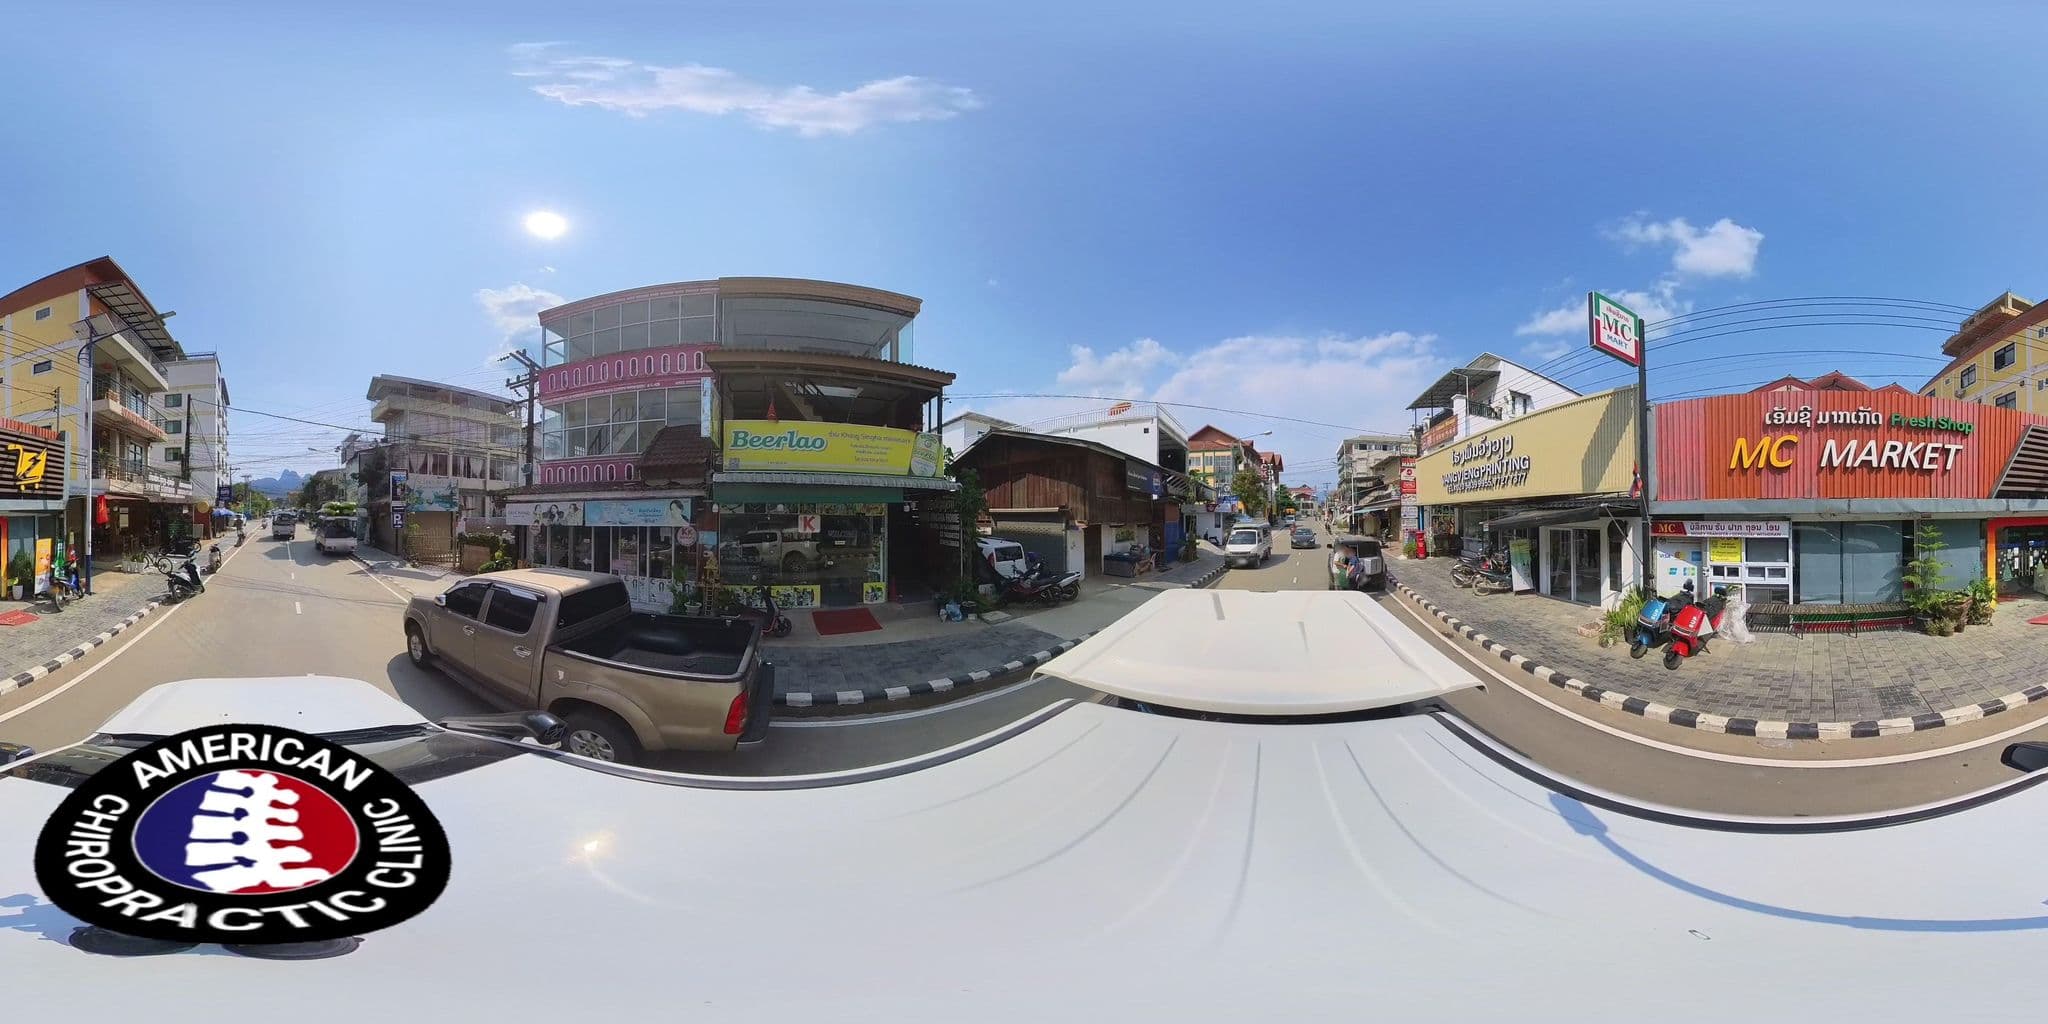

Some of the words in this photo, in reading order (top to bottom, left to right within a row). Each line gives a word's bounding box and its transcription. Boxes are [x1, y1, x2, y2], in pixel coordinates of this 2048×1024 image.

[1602, 312, 1632, 342] MC
[1606, 334, 1628, 350] MART
[1890, 413, 1936, 429] Fresh
[1937, 417, 1975, 435] Shop
[730, 429, 828, 452] Beerlao
[1730, 435, 1798, 469] MC
[1820, 439, 1964, 470] MARKET
[1480, 455, 1529, 476] PRINTING
[803, 516, 815, 531] K
[1658, 523, 1676, 533] MC
